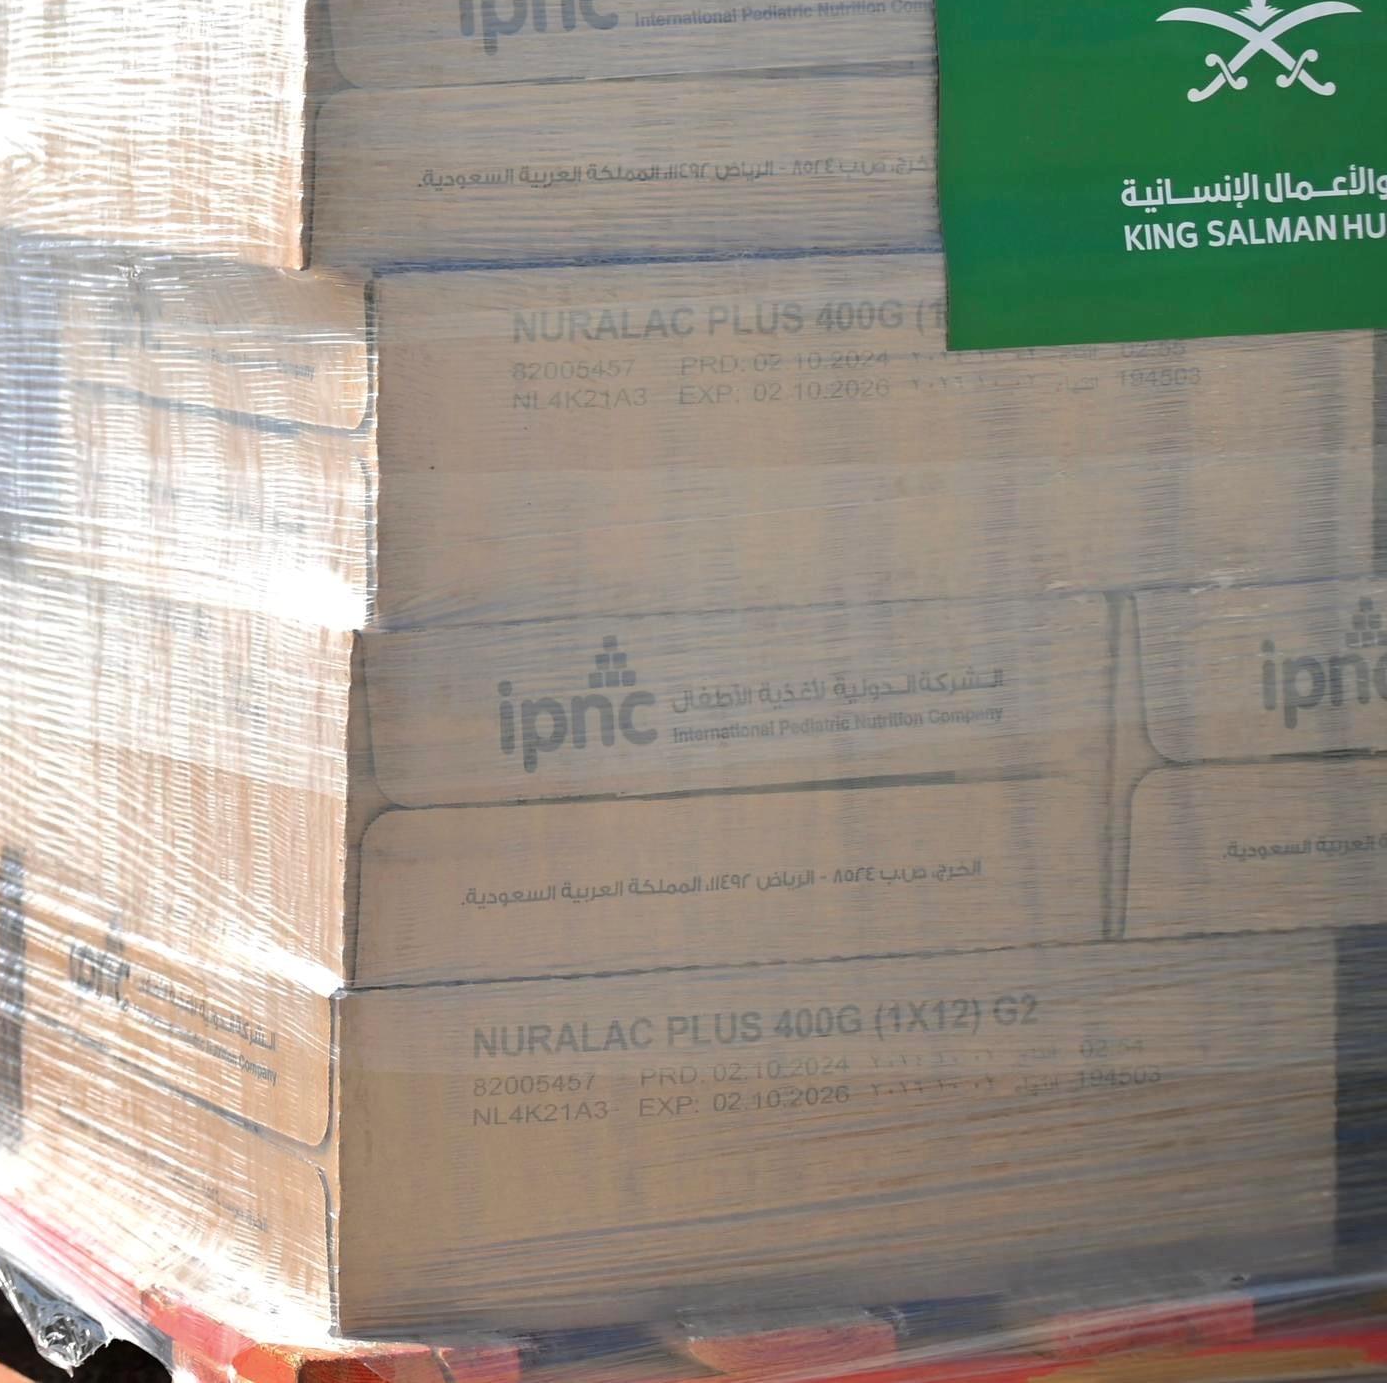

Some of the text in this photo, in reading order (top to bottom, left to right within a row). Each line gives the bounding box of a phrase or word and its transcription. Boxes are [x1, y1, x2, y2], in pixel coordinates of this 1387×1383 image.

[635, 7, 738, 28] International
[1120, 172, 1259, 214] الإنسانية
[1125, 222, 1198, 251] KING
[1208, 215, 1337, 248] SALMAN
[513, 307, 695, 344] NURALAC
[708, 302, 805, 337] PLUS
[815, 299, 905, 332] 400G
[498, 680, 658, 774] ipnc
[673, 722, 775, 744] International
[928, 706, 1003, 729] Company
[561, 880, 623, 904] العربية
[628, 876, 703, 898] المملكة
[473, 994, 1039, 1059] NURALAC PLUS 400G (1X12) G2
